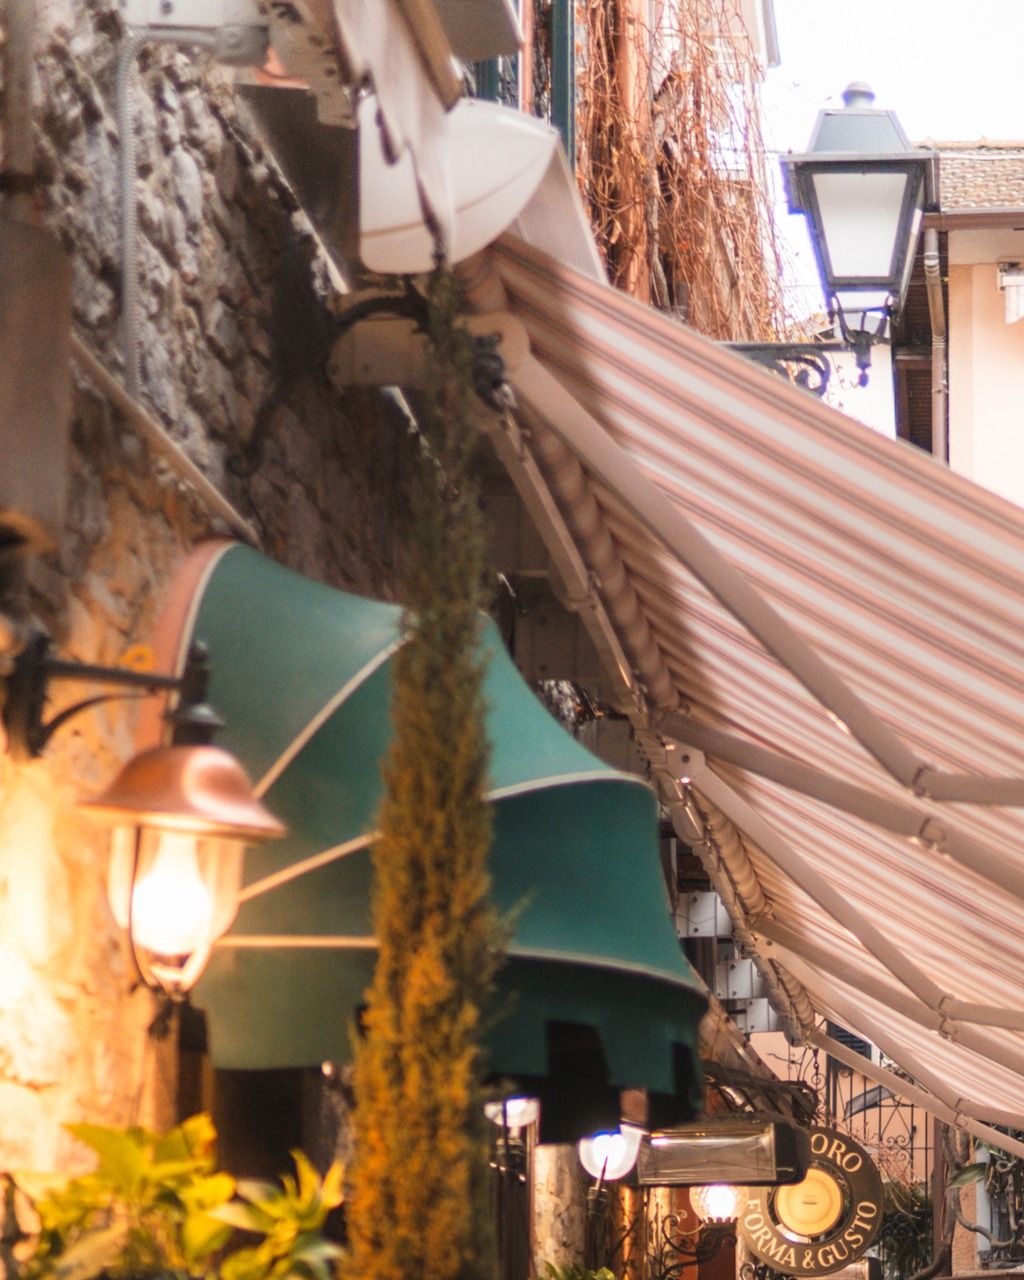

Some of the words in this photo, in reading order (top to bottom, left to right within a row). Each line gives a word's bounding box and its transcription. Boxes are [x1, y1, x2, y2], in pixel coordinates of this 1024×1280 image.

[744, 1199, 797, 1267] FORMA
[802, 1250, 816, 1268] &
[818, 1201, 877, 1267] GUSTO
